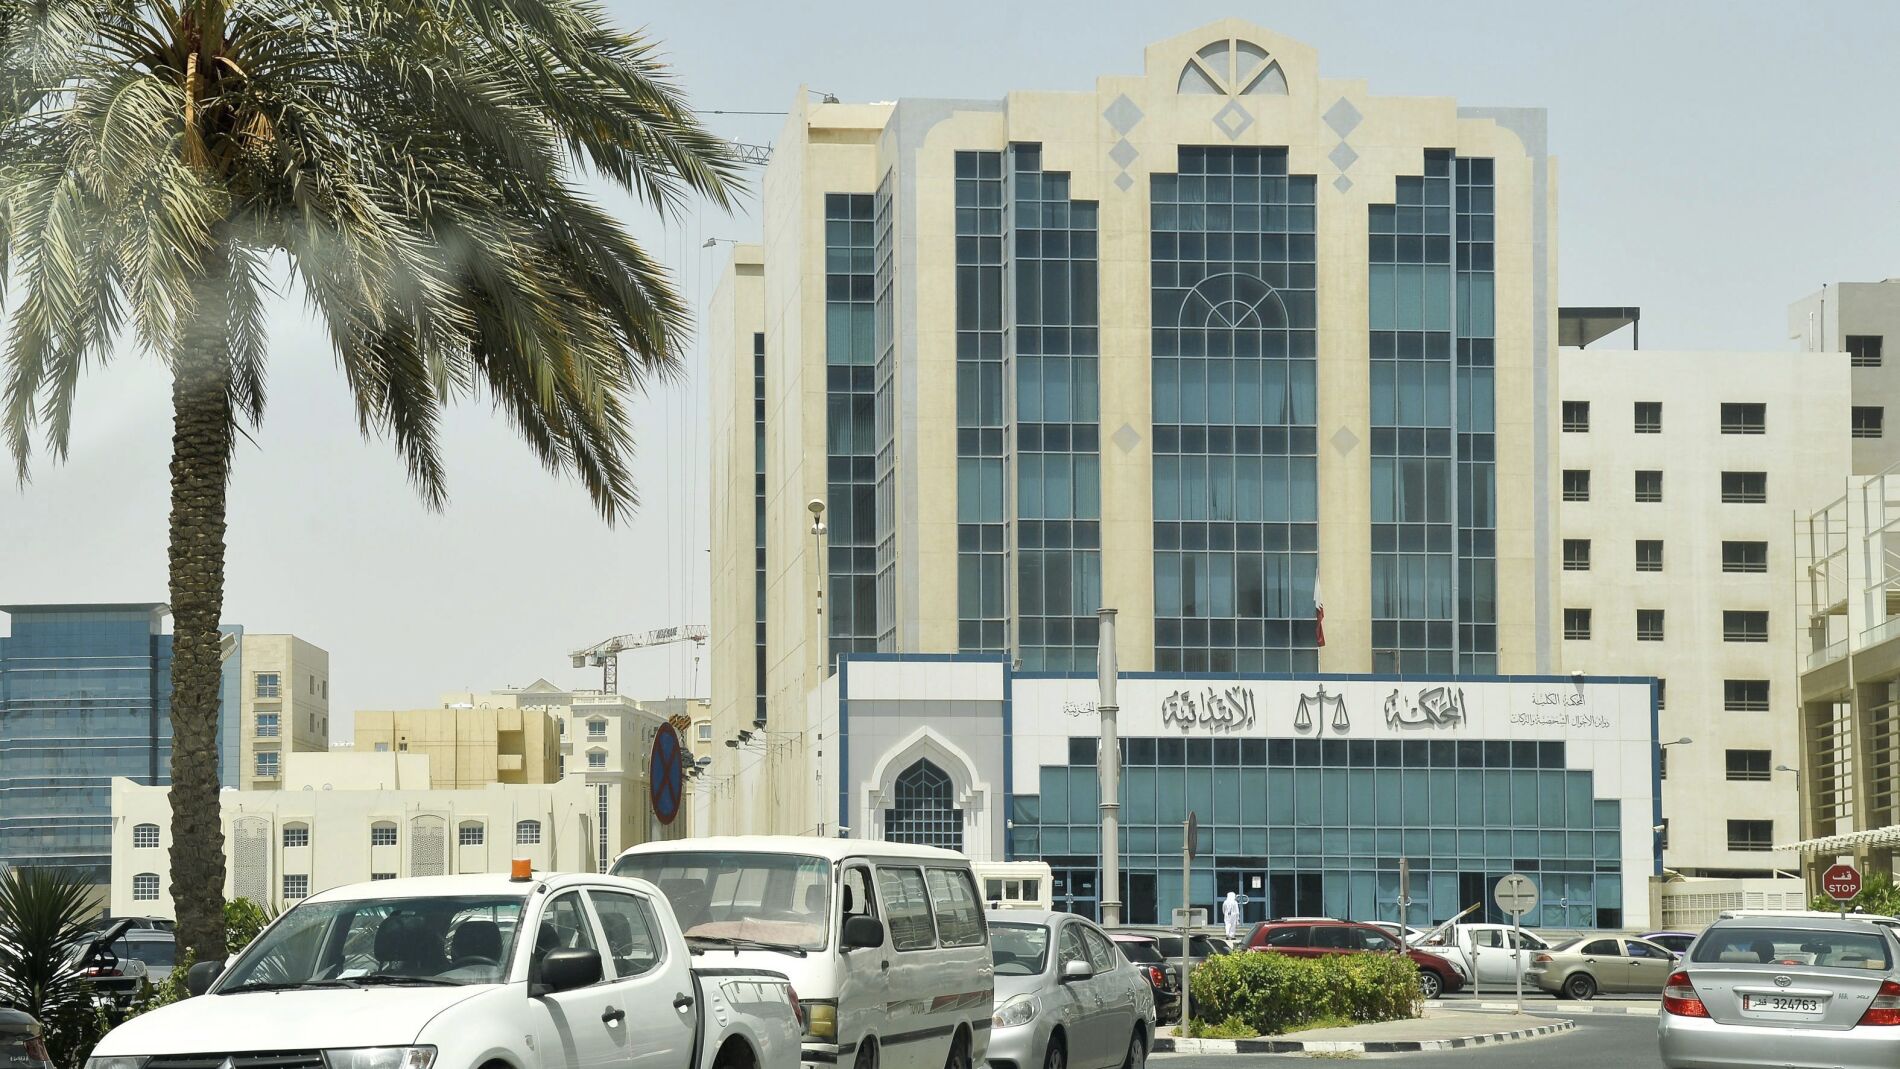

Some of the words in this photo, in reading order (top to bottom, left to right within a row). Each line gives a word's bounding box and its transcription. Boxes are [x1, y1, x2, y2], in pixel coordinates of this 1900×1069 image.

[1832, 870, 1852, 880] قف
[1828, 884, 1857, 893] STOP
[1772, 998, 1817, 1011] 324763
